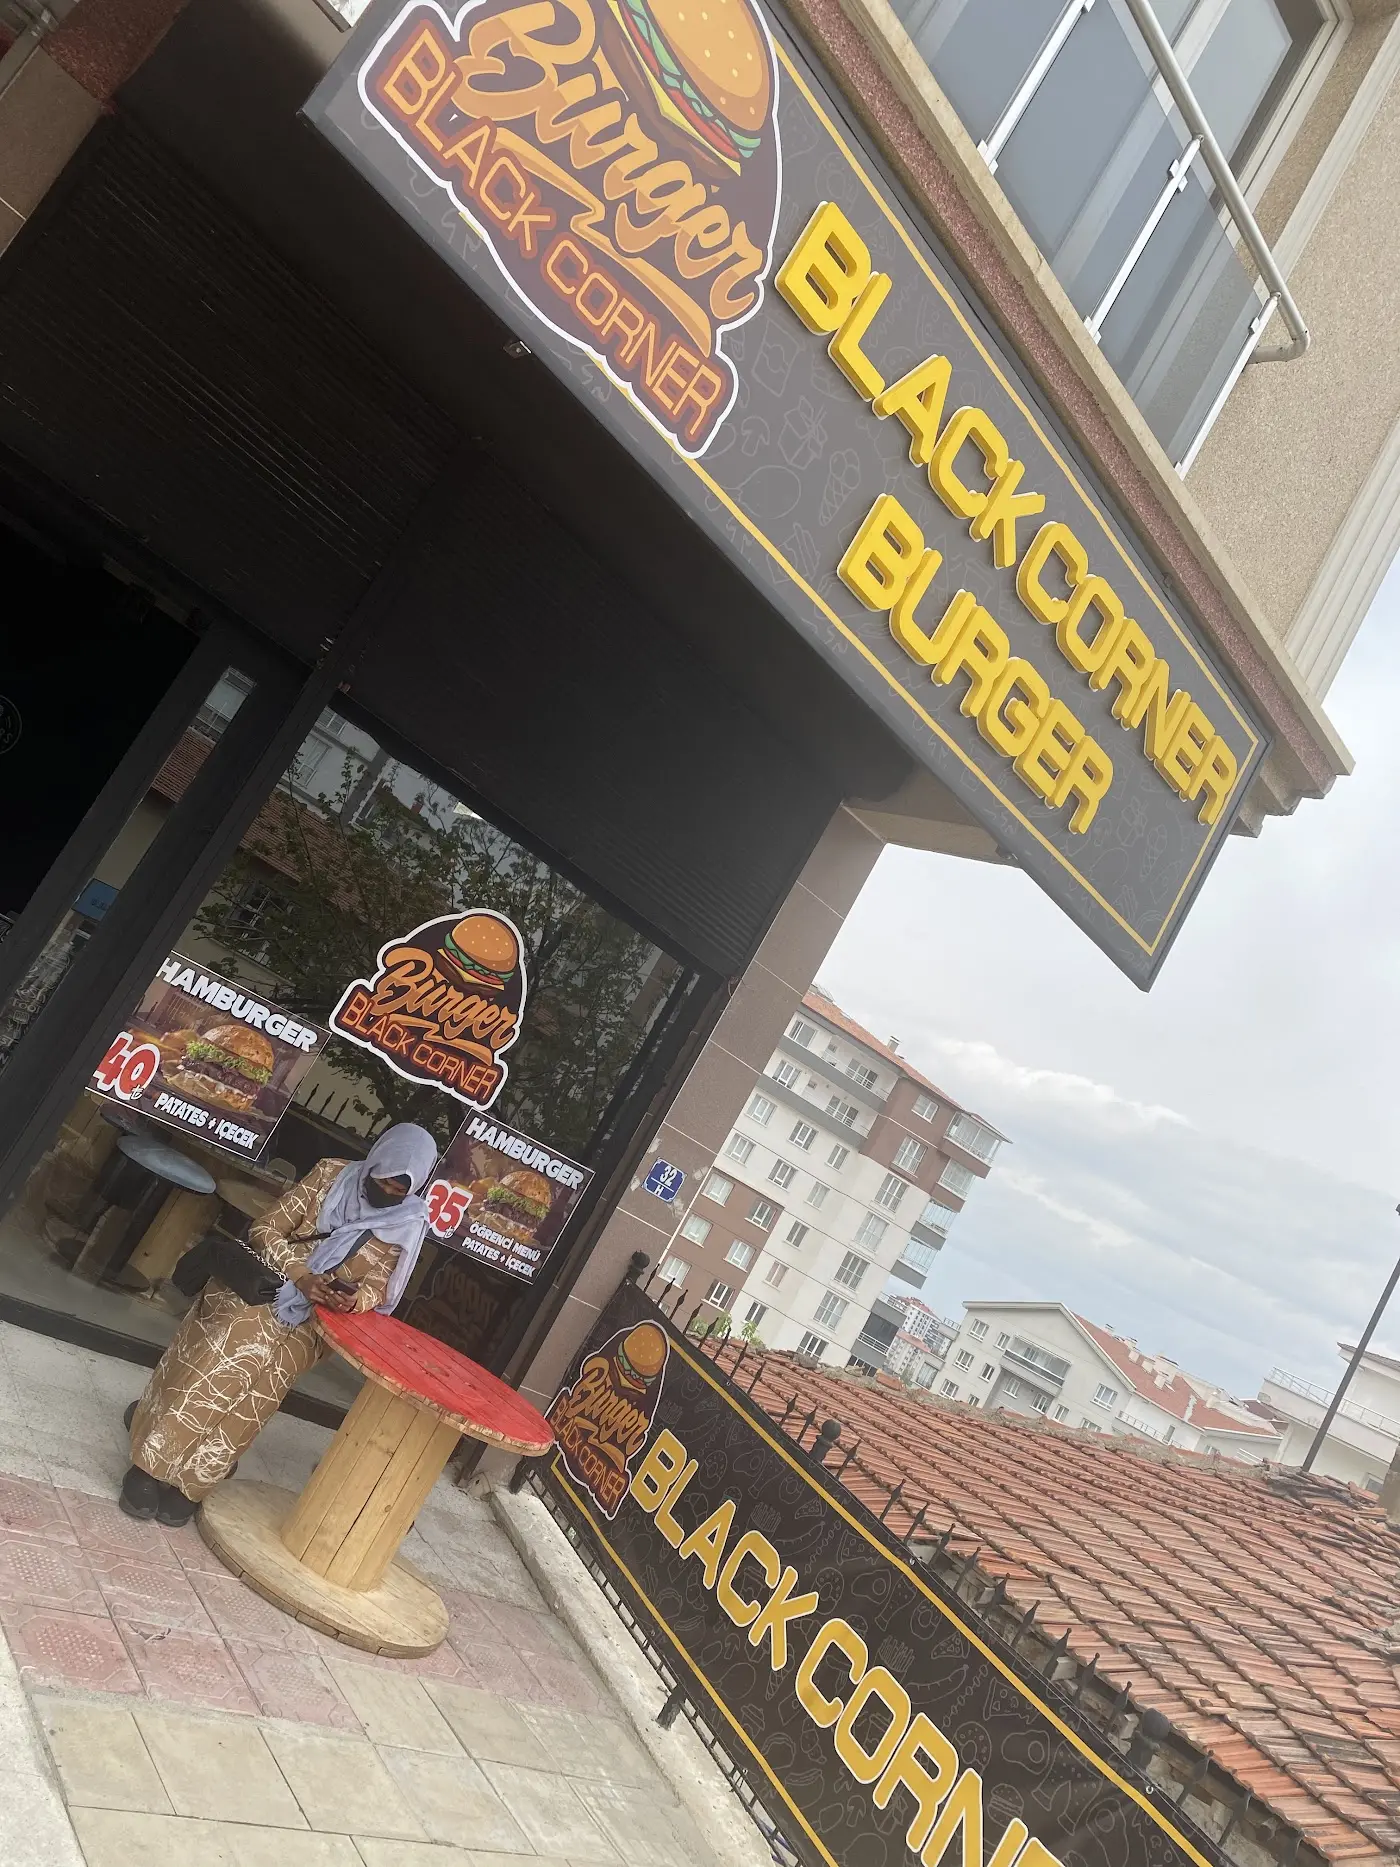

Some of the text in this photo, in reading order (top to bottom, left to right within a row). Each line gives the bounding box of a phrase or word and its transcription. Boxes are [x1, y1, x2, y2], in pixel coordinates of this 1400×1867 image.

[451, 0, 763, 319] Burger
[382, 26, 723, 436] BLACK CORNER
[774, 200, 1238, 825] BLACK CORNER
[836, 492, 1114, 834] BURGER
[155, 957, 318, 1053] HAMBURGER
[341, 991, 498, 1099] BLACK CORNER
[369, 946, 517, 1049] Burger
[154, 1092, 210, 1129] PATATES
[464, 1117, 584, 1190] HAMBURGER
[426, 1179, 474, 1238] 35
[654, 1184, 665, 1196] H
[659, 1165, 678, 1187] 32
[461, 1237, 500, 1262] PATATES
[469, 1221, 541, 1262] ÖĞRENCİ MENÜ
[550, 1395, 626, 1510] BLACK CORNER
[565, 1356, 650, 1456] Burger
[629, 1428, 1068, 1867] BLACK CORN
